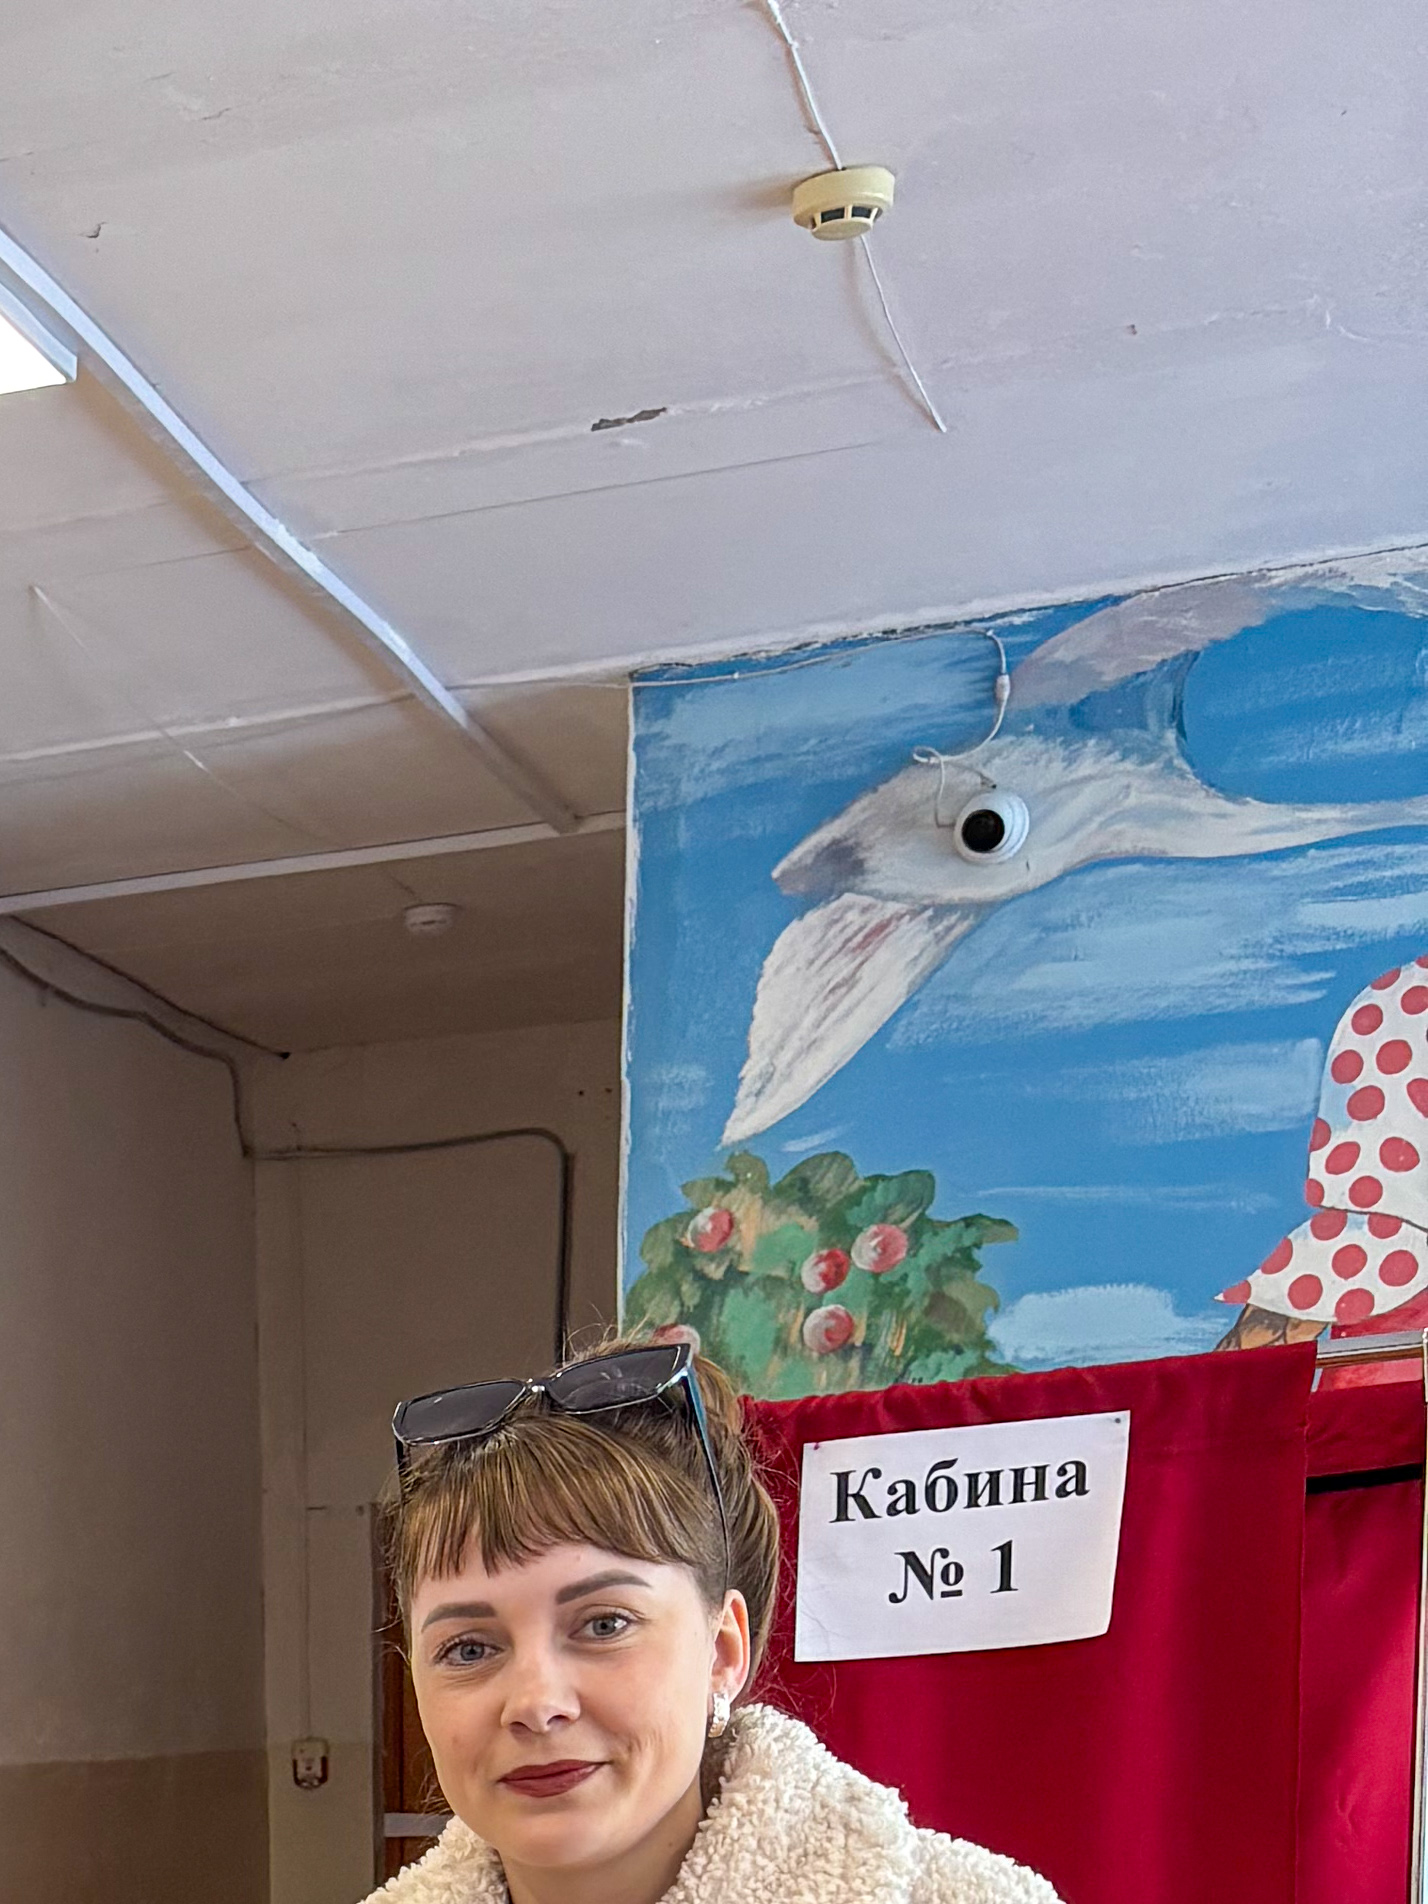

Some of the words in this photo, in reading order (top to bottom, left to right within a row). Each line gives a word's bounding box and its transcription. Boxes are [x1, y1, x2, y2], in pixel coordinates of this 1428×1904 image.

[829, 1457, 1091, 1524] Кабина
[888, 1546, 965, 1604] №
[989, 1539, 1019, 1595] 1
